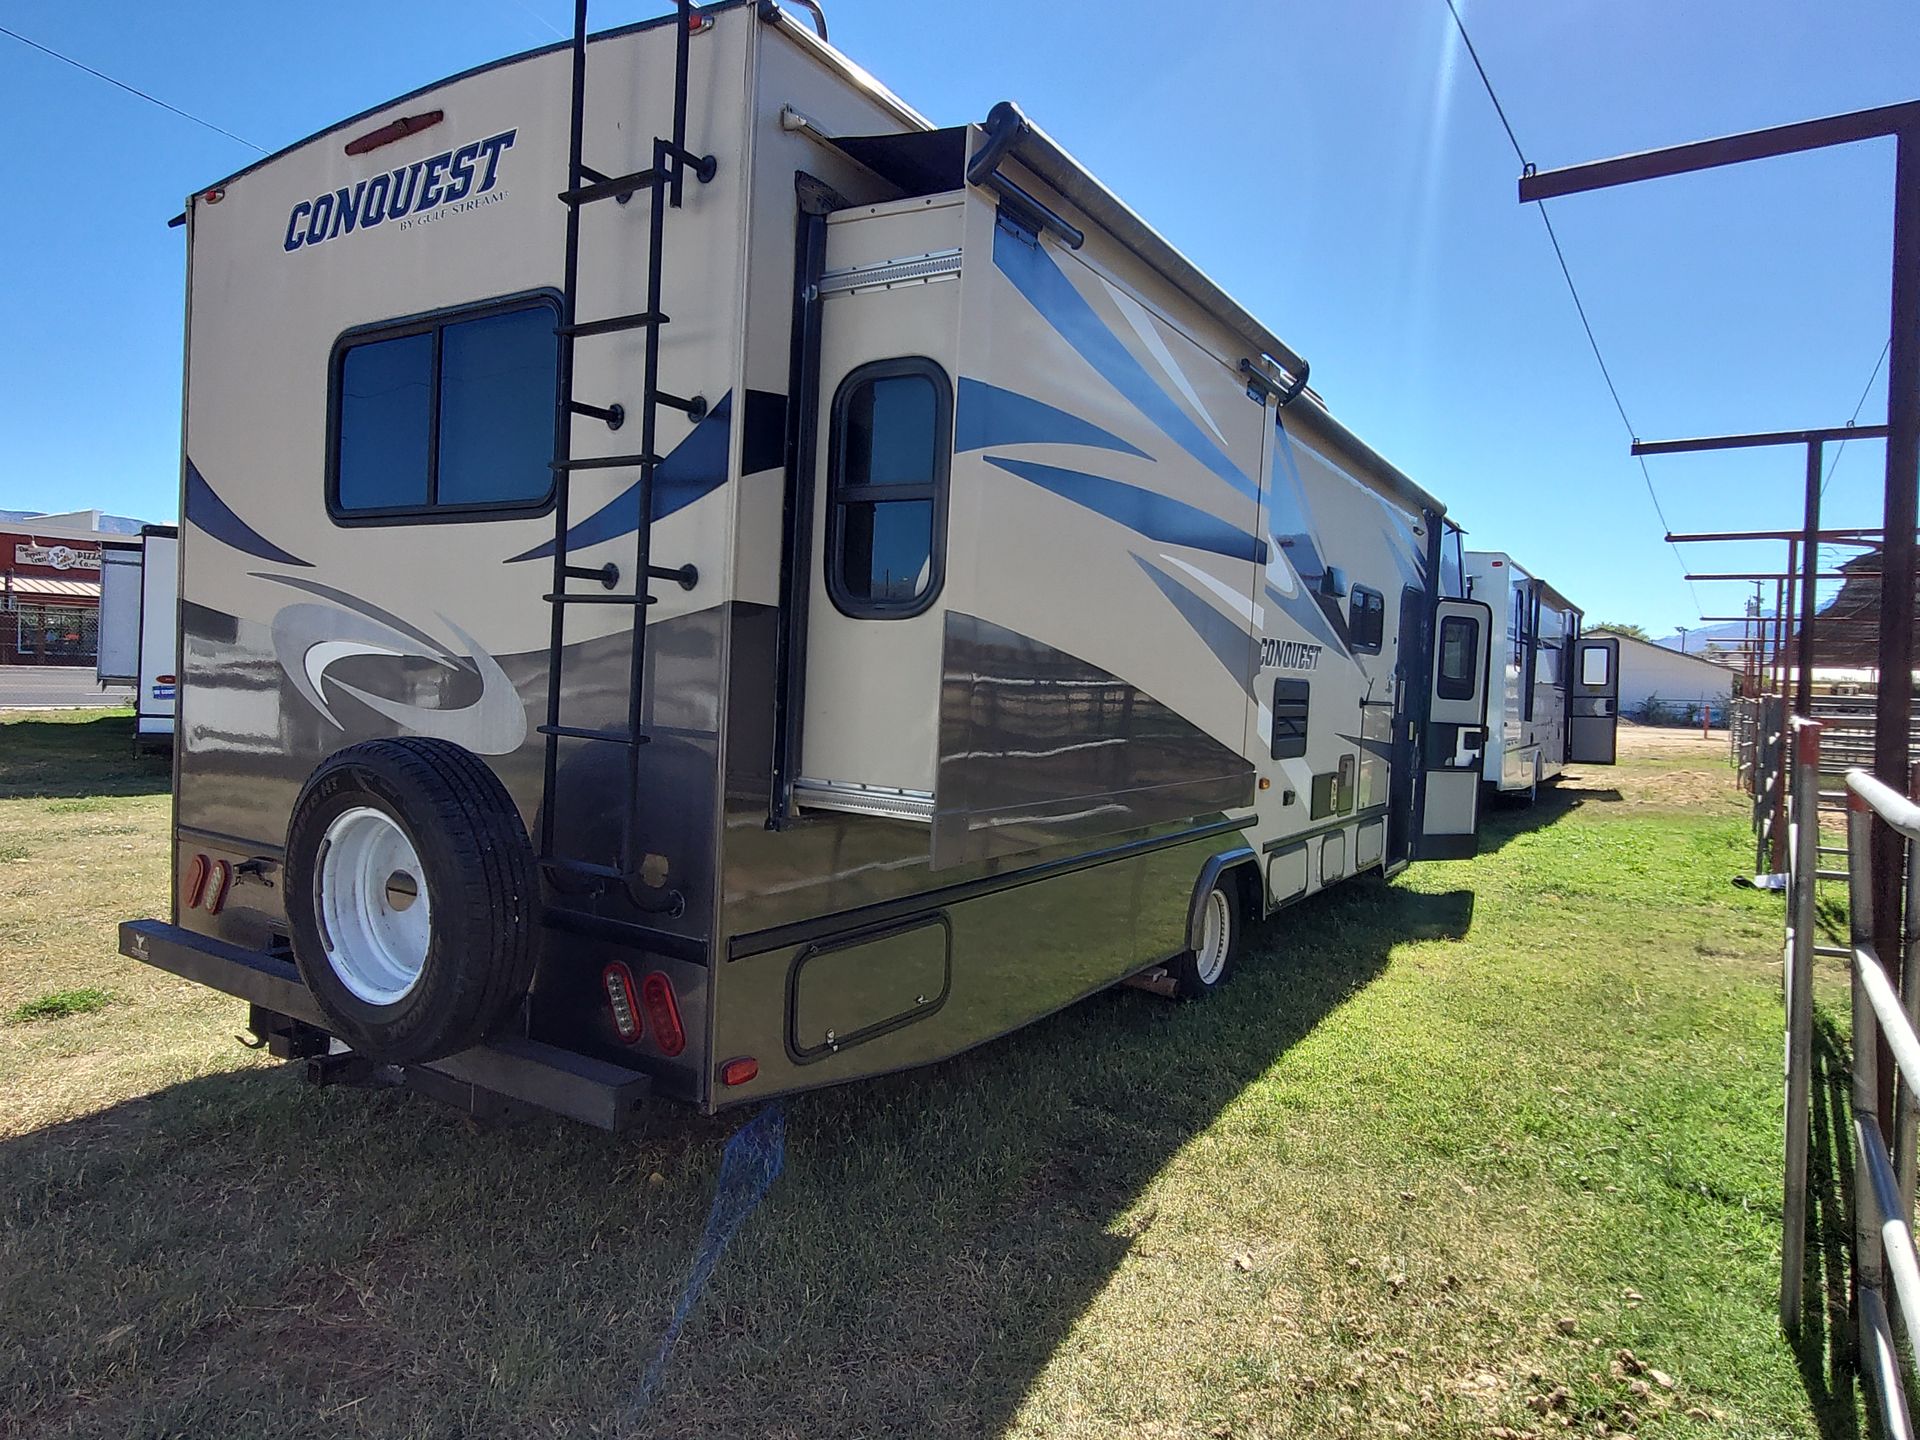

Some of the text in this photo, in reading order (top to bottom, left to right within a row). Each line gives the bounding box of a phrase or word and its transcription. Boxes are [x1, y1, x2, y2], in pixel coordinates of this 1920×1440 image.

[285, 128, 518, 252] CONQUEST
[400, 219, 414, 231] BY
[417, 208, 448, 226] GULF
[1260, 638, 1322, 670] CONQUEST
